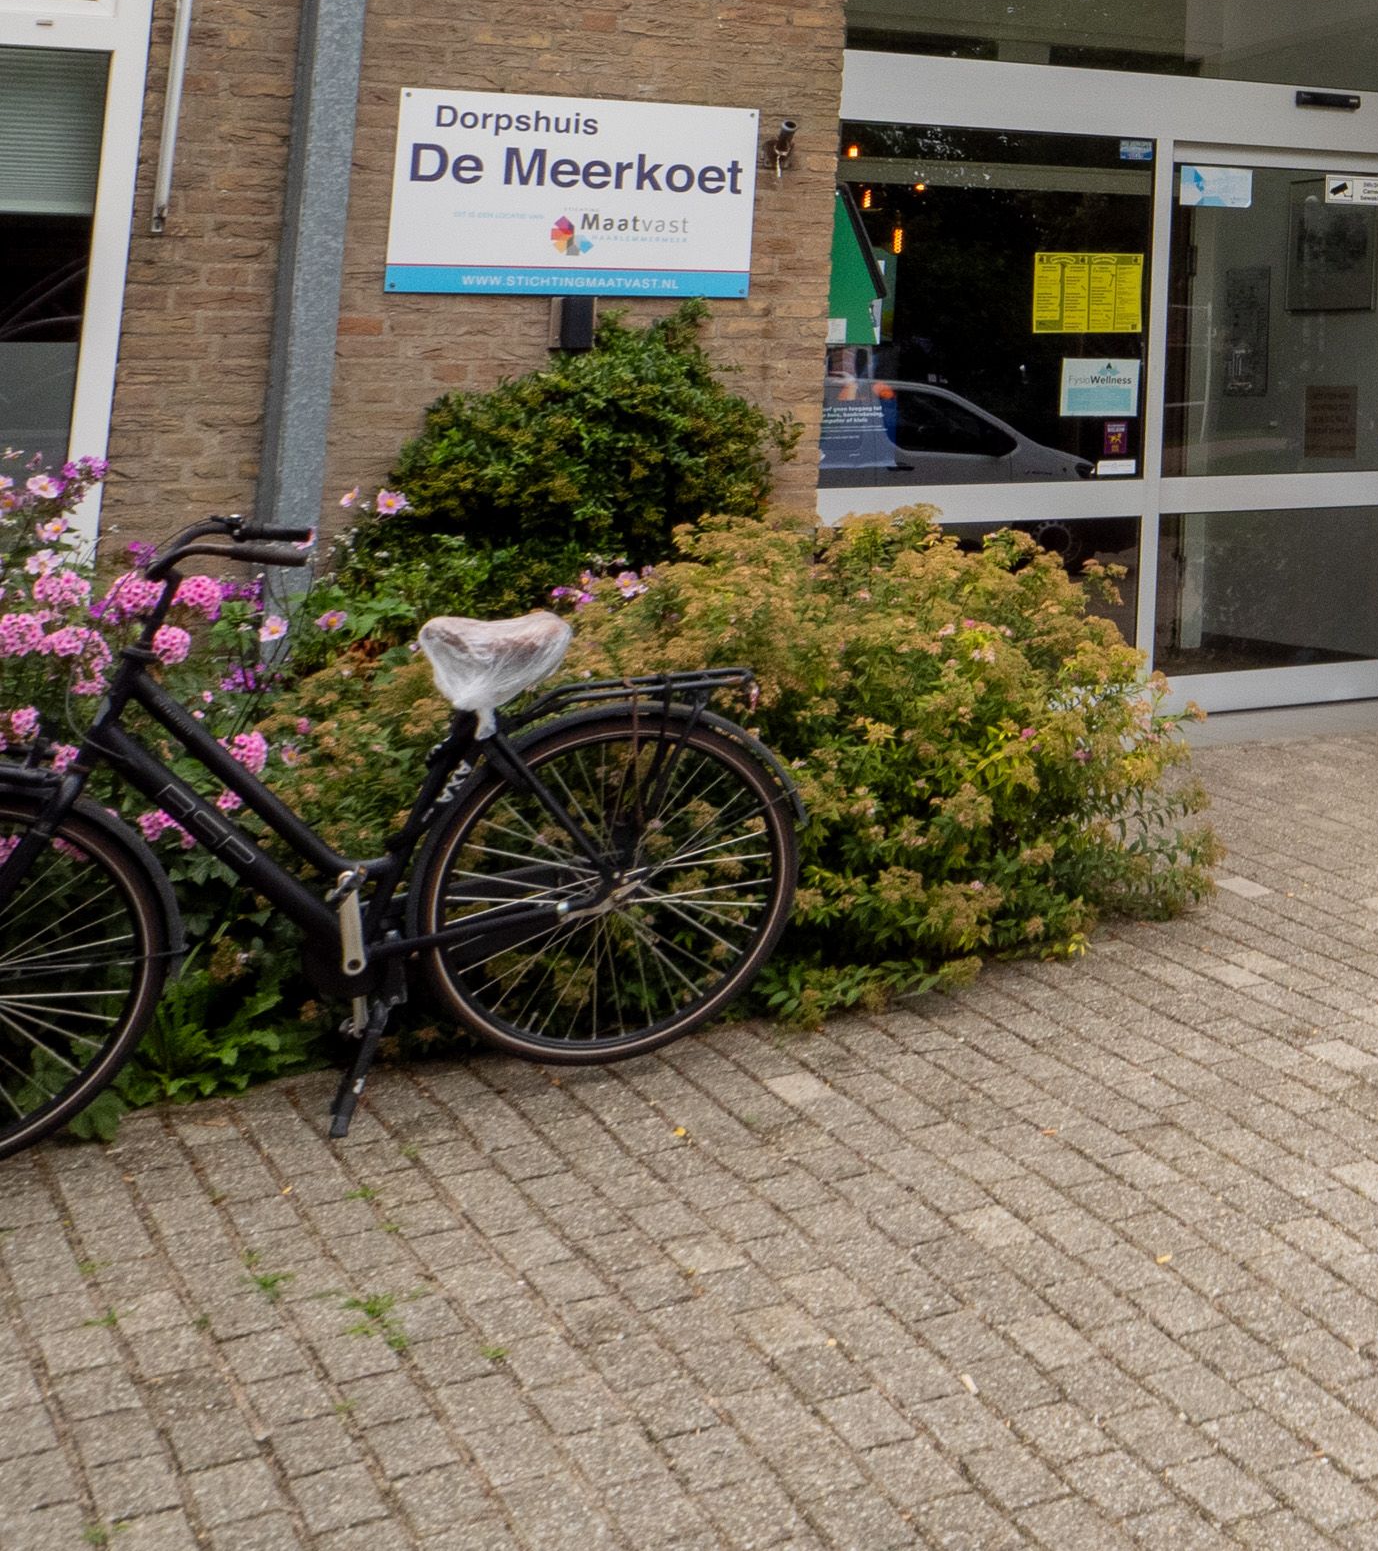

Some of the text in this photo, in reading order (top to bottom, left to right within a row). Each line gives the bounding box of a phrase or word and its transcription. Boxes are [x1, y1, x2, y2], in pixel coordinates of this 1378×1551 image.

[434, 104, 599, 136] Dorpshuis
[409, 142, 743, 195] De Meerkoet
[581, 213, 689, 234] Maatvast
[462, 275, 679, 290] WWW.STICHTINGMAATVAST.NL
